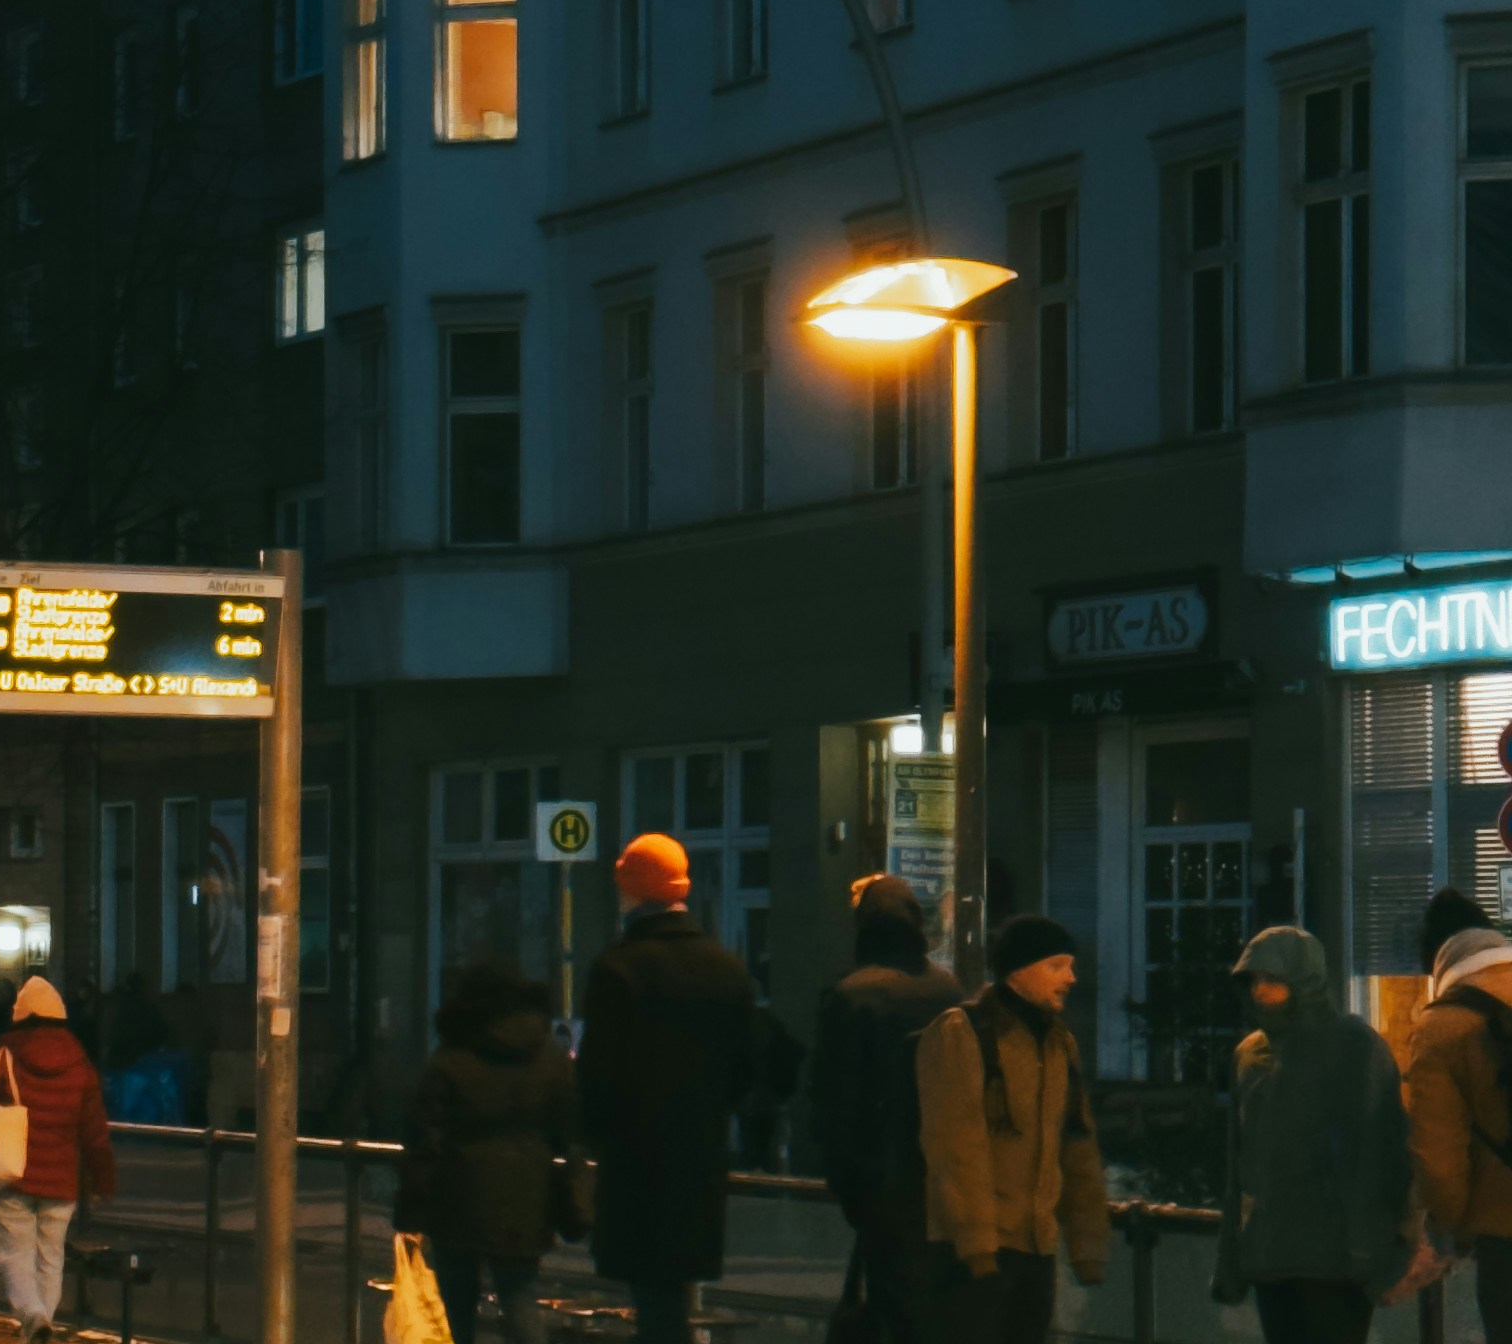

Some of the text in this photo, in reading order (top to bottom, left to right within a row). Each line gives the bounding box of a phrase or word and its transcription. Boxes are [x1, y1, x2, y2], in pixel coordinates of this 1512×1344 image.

[20, 573, 41, 585] Ziel
[208, 579, 265, 593] Abfahrt in
[221, 603, 265, 623] 2 min
[1067, 597, 1189, 654] PIK-AS
[1335, 589, 1512, 662] FECHTN
[218, 636, 261, 656] 6 min
[0, 673, 12, 689] U
[1100, 689, 1124, 712] AS
